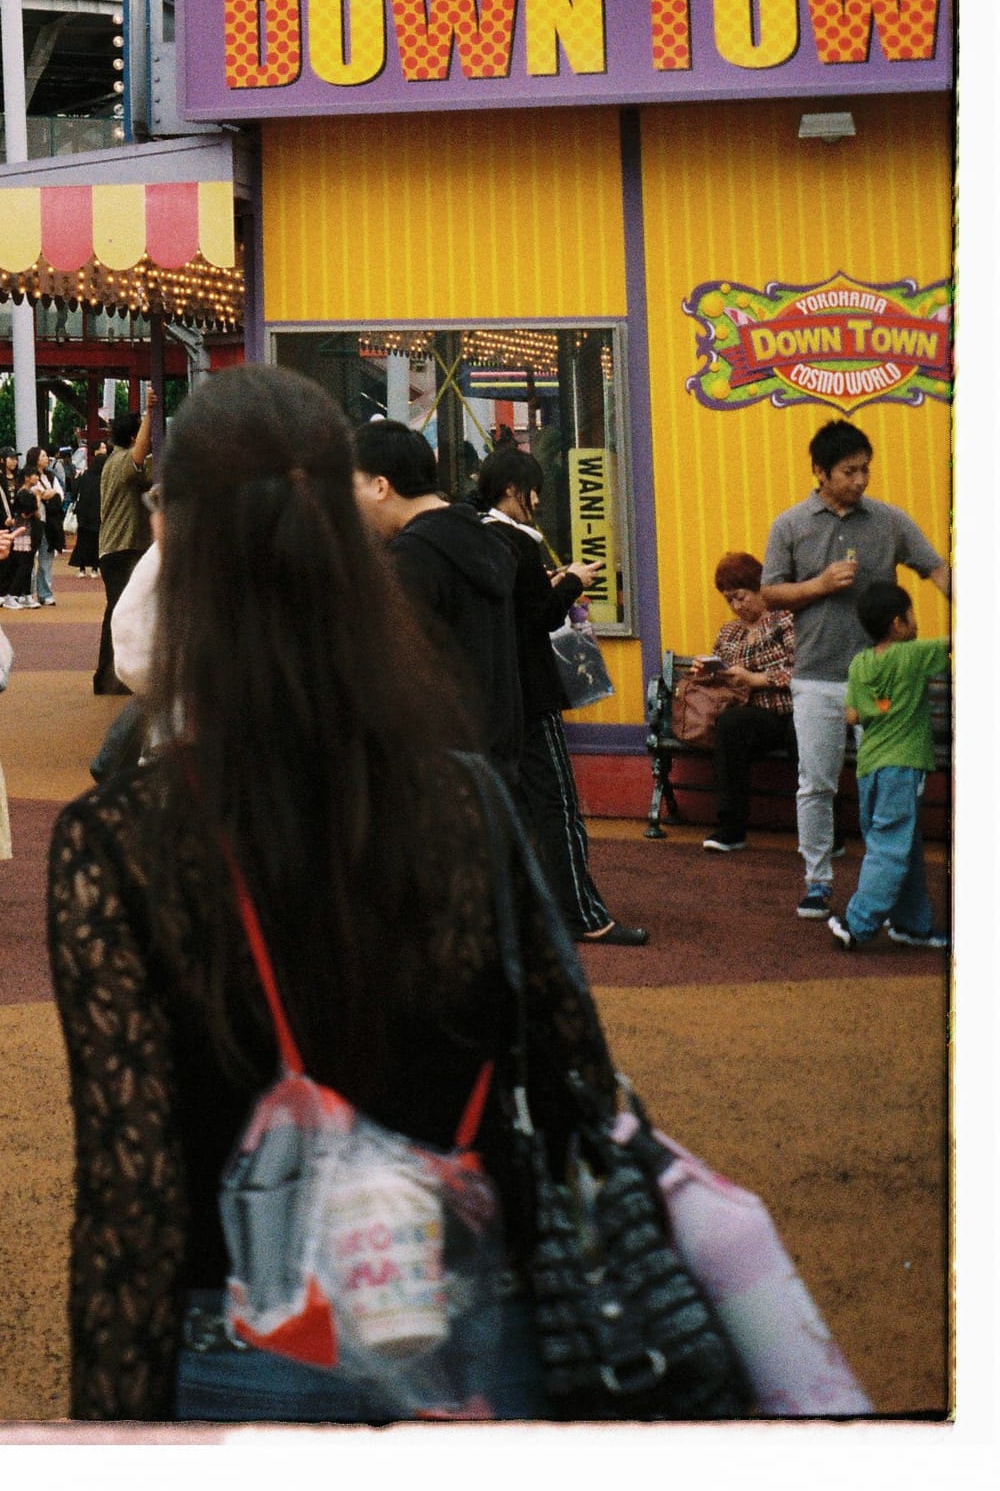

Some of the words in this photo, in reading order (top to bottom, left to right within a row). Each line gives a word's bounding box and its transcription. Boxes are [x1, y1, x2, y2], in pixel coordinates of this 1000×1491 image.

[796, 291, 887, 315] YOKOHAMA
[750, 326, 842, 361] DOWN
[847, 319, 939, 359] TOWN
